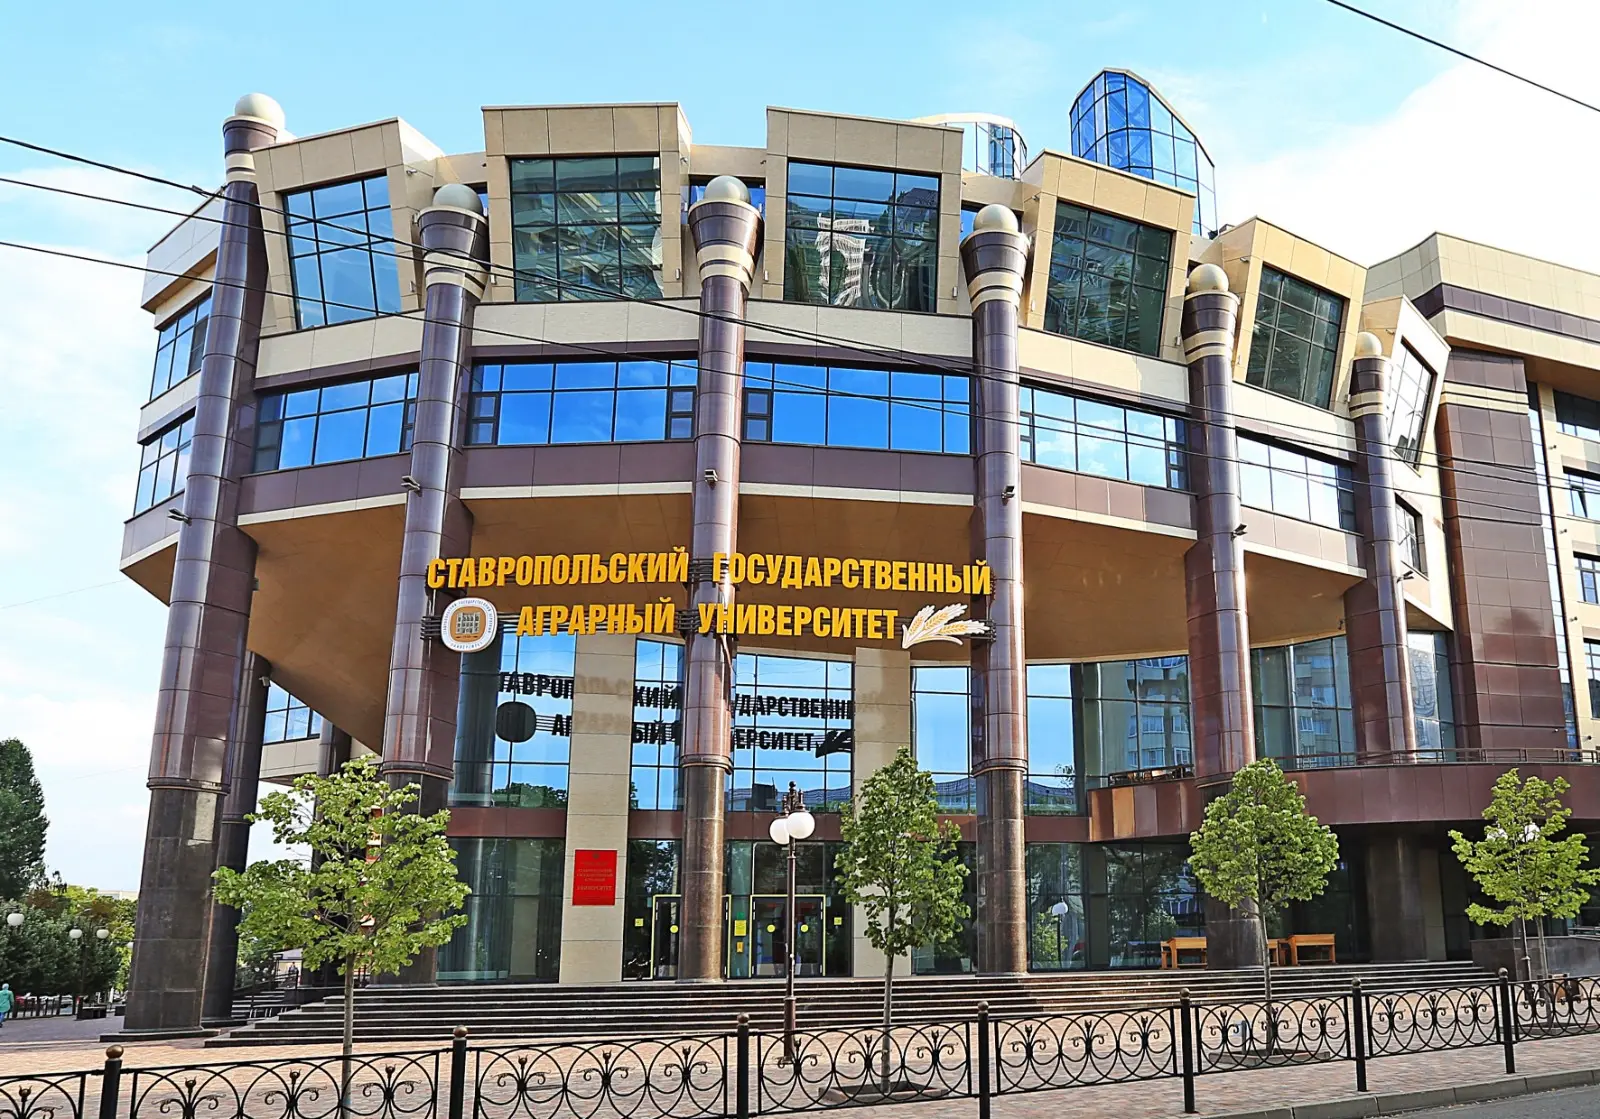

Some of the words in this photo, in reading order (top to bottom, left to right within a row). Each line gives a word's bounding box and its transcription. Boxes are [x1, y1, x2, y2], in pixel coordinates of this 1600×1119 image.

[427, 546, 689, 589] СТАВРОПОЛЬСКИЙ
[712, 552, 992, 595] ГОСУДАРСТВЕННЫЙ
[516, 596, 675, 637] АГРАРНЫЙ
[697, 602, 899, 640] УНИВЕРСИТЕТ
